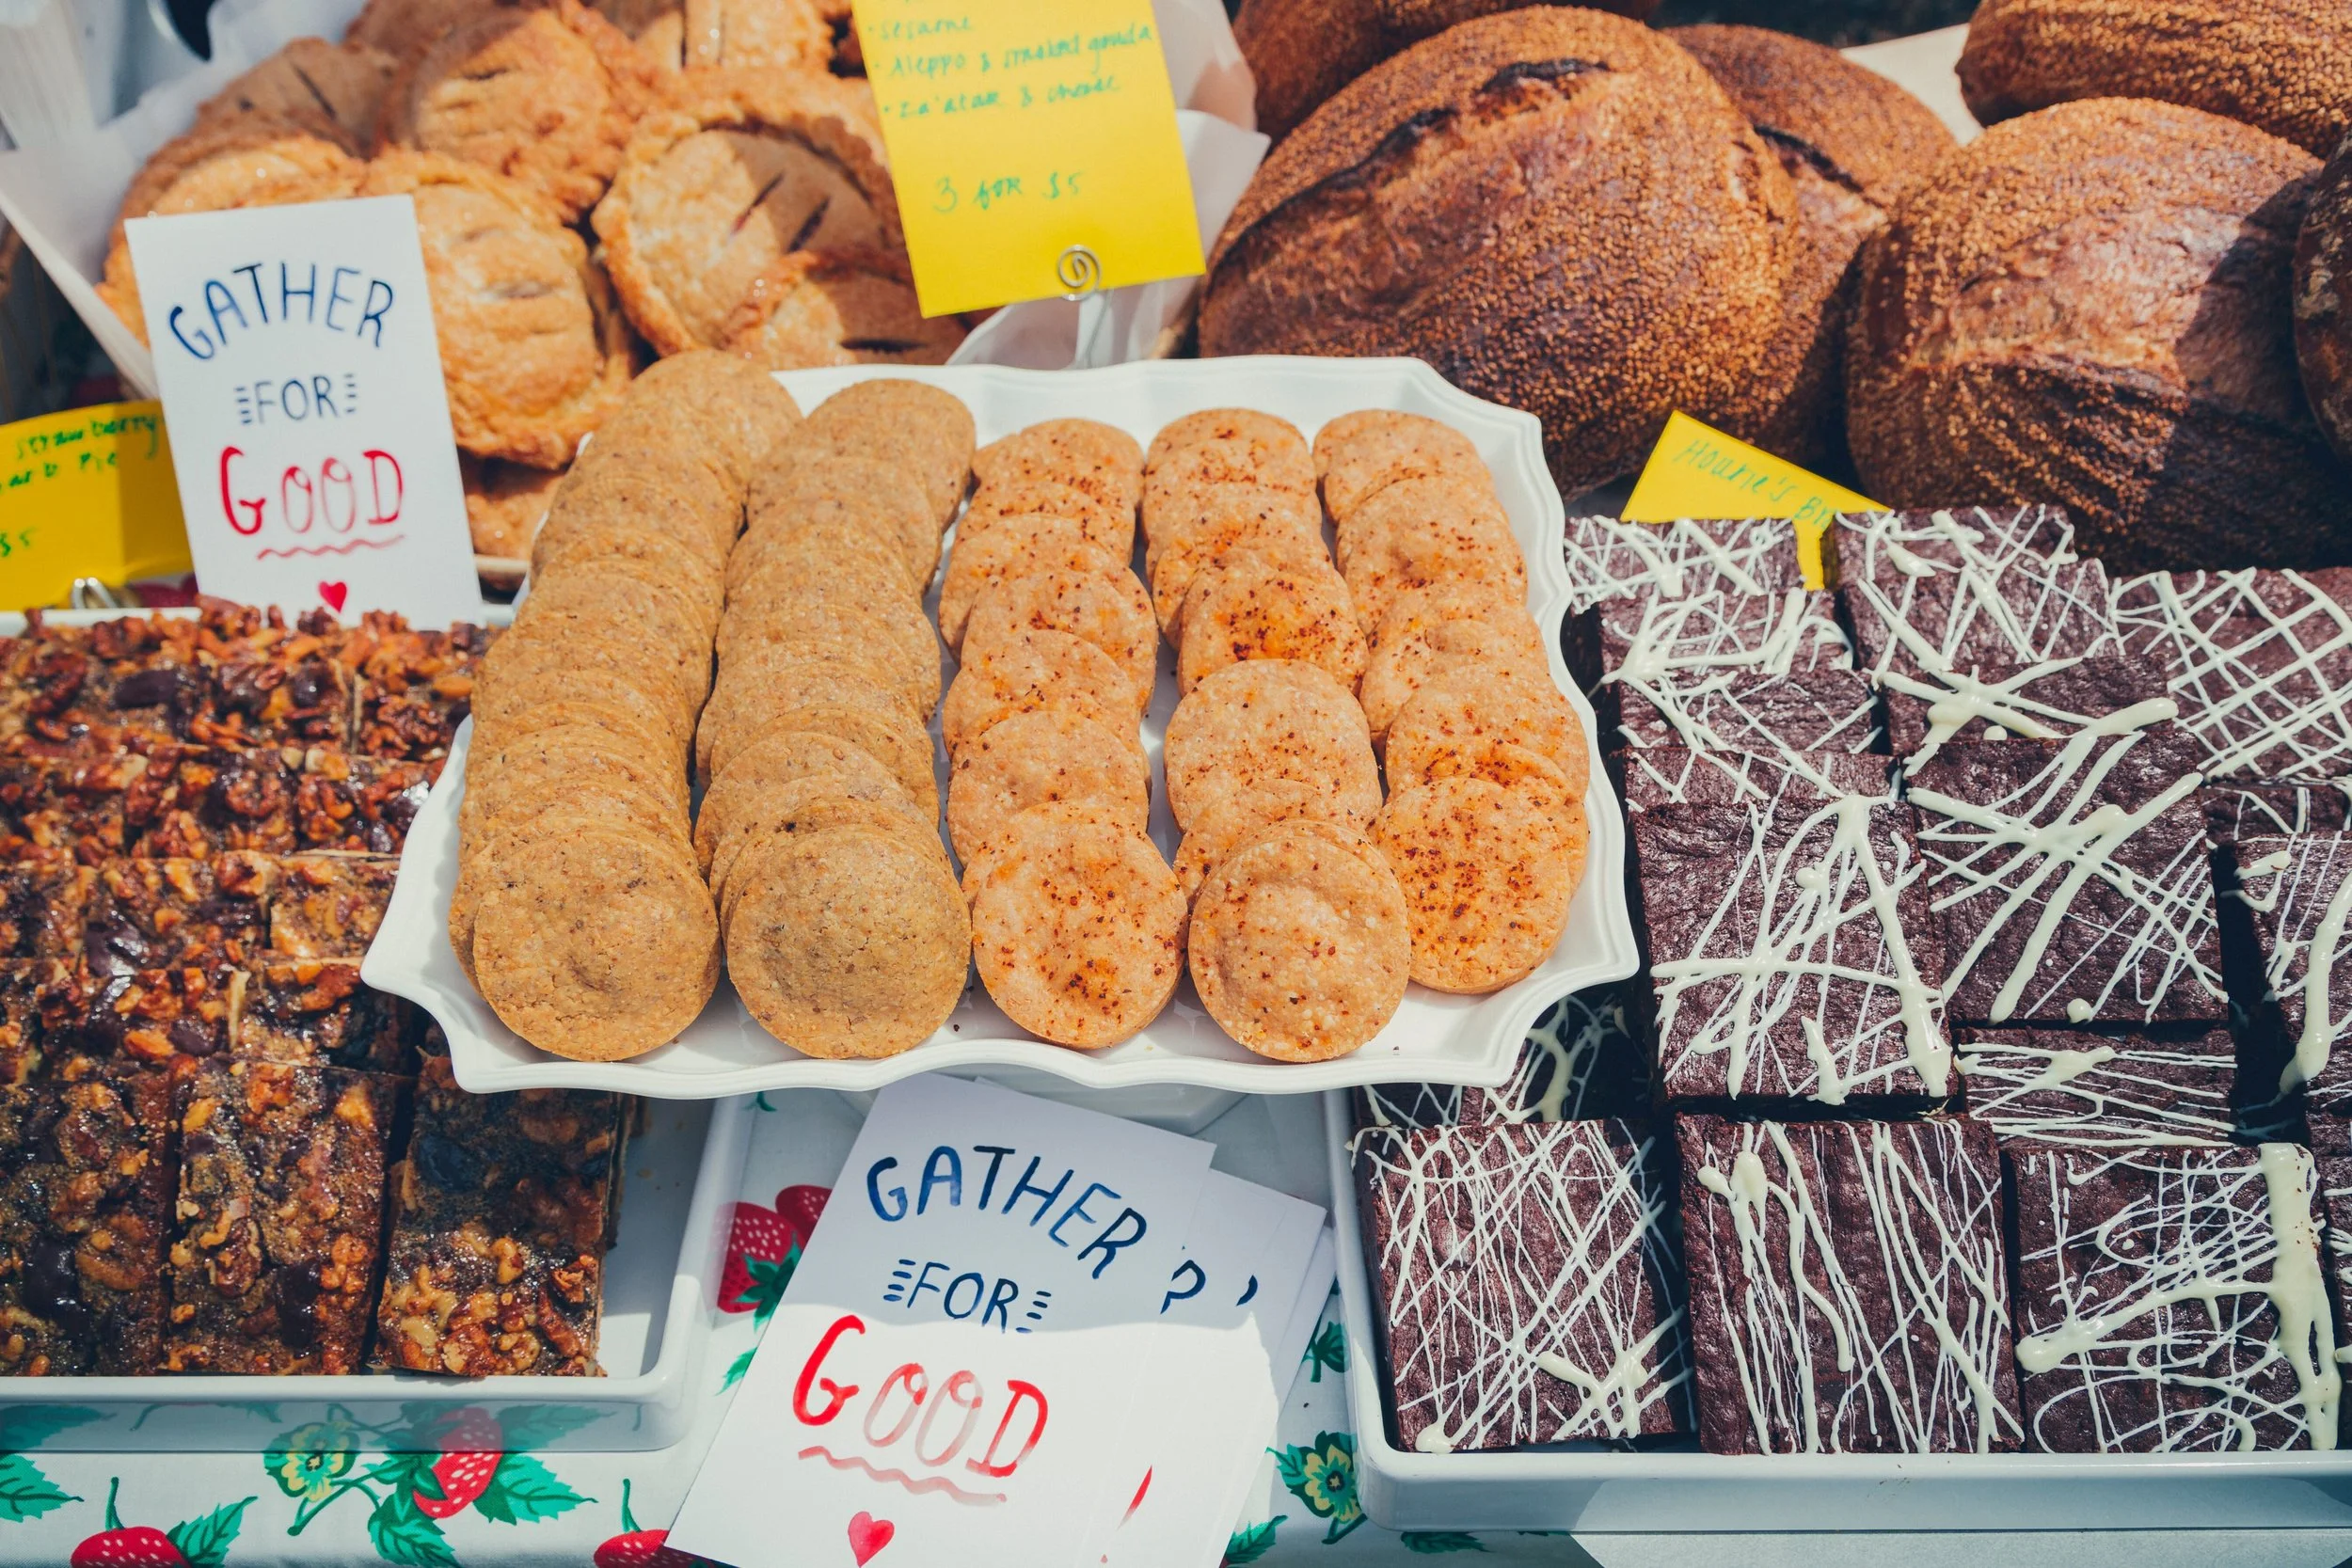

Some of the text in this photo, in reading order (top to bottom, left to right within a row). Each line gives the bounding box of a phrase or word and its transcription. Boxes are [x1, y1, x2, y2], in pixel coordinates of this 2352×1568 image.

[888, 53, 967, 79] Aleppo
[1088, 22, 1152, 75] gouda
[932, 176, 958, 213] 3
[169, 261, 394, 360] GATHER
[255, 375, 340, 424] FOR
[866, 1145, 1148, 1280] GATHER
[906, 1261, 1019, 1333] FOR
